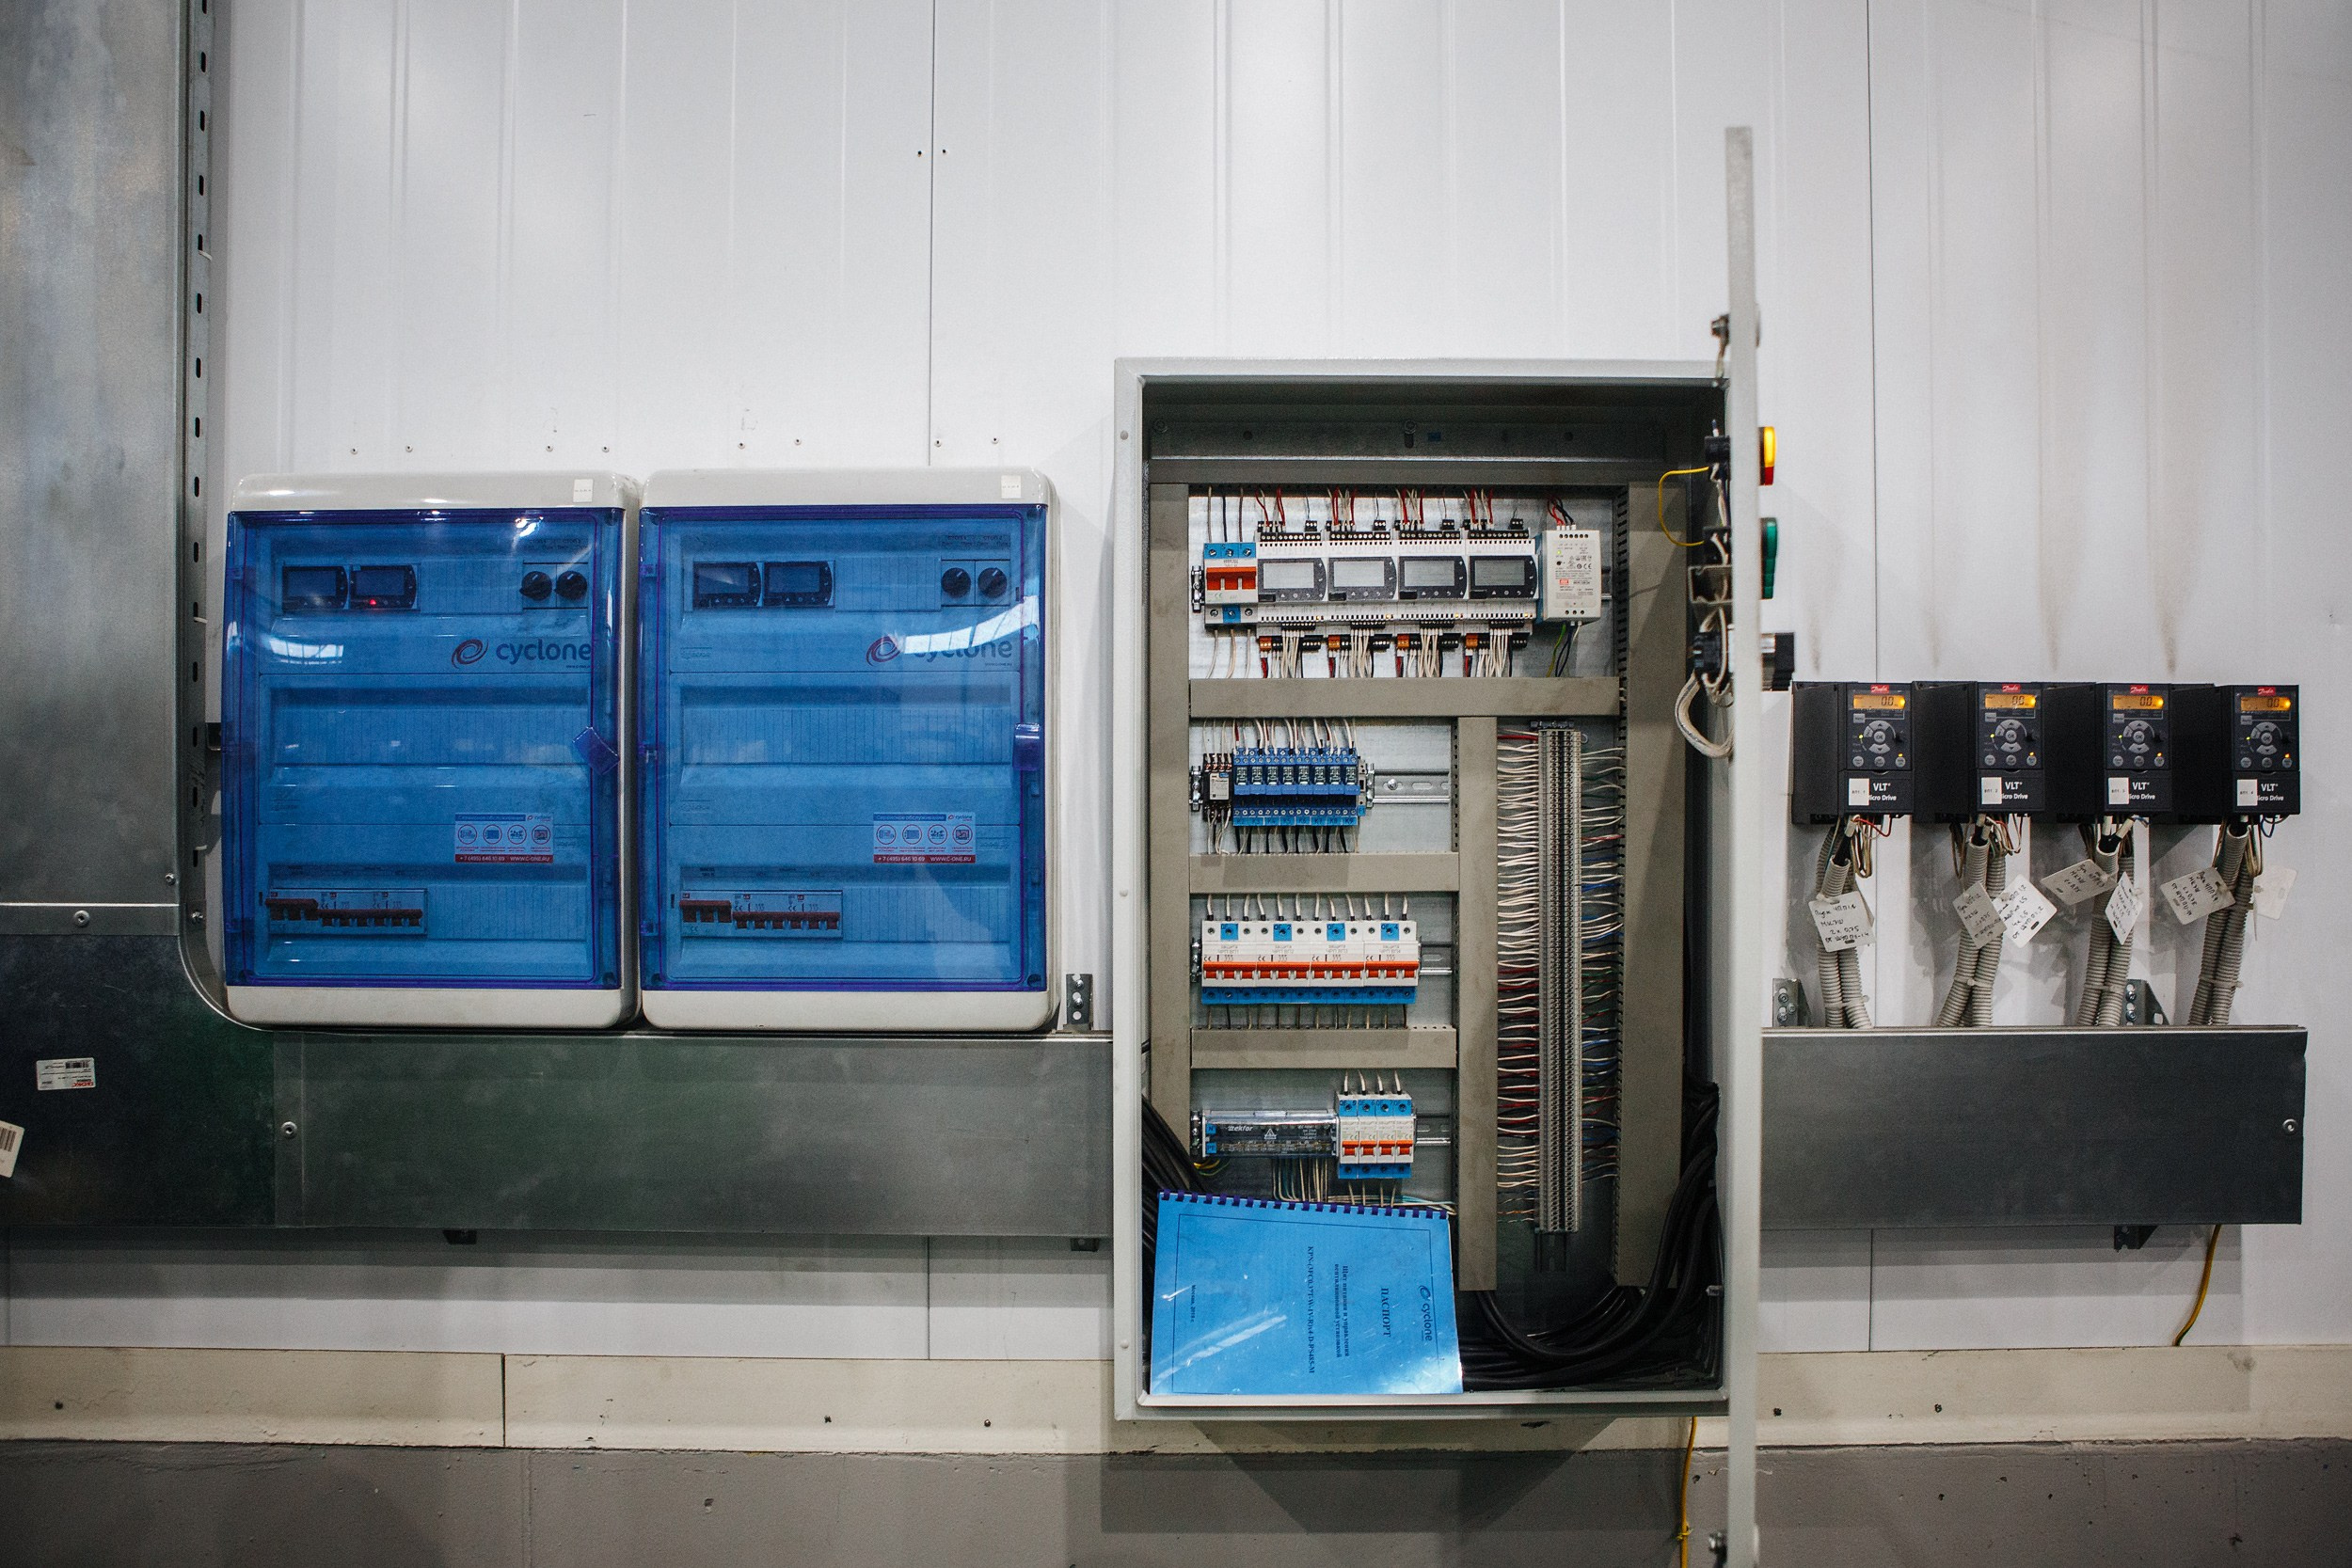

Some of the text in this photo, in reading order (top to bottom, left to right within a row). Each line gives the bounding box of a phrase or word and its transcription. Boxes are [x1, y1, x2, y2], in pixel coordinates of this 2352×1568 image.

[496, 639, 592, 665] cyclone
[1380, 1288, 1391, 1338] ПАСПОРТ
[1421, 1303, 1433, 1341] cyclone
